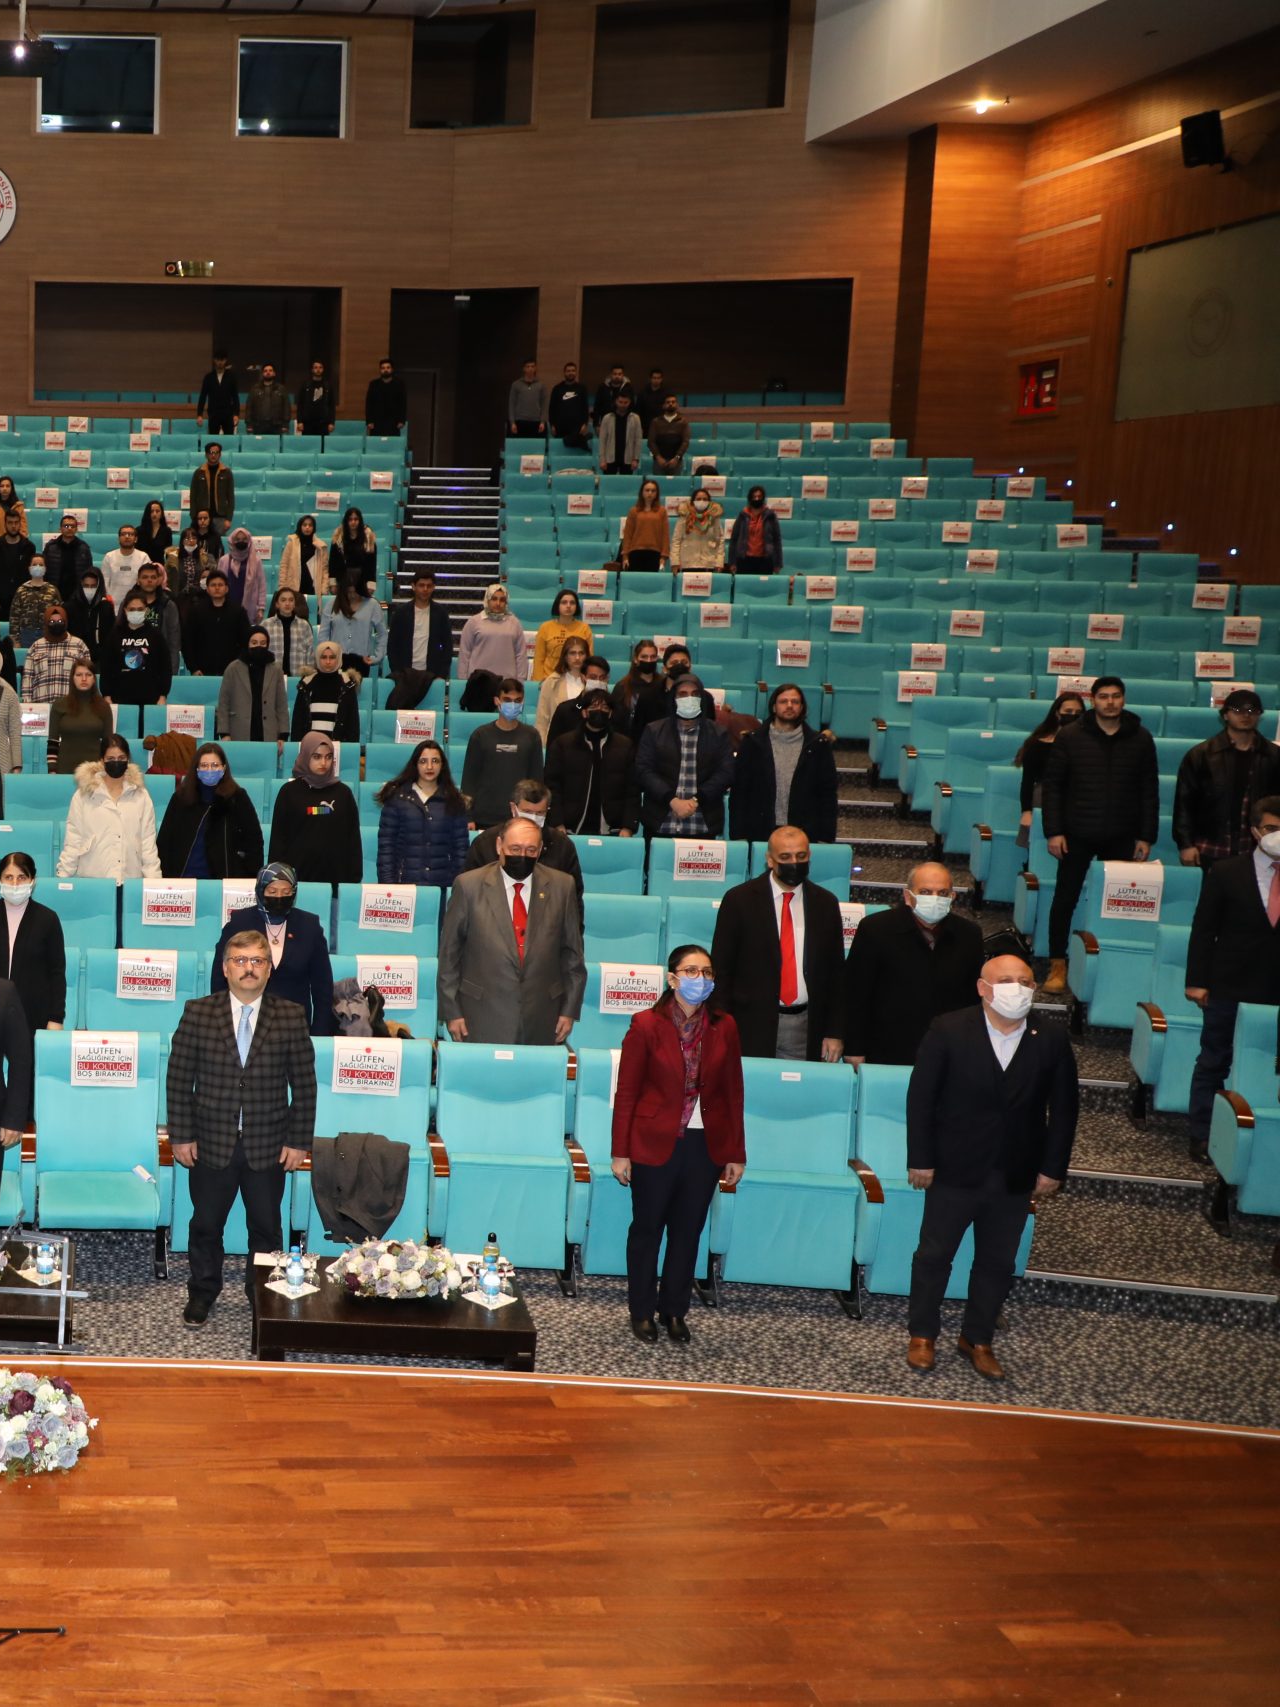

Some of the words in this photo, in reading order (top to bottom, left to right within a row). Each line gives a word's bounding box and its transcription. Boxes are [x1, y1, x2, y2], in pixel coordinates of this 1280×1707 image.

[121, 638, 150, 646] NASA
[375, 898, 402, 906] LÜTFEN
[136, 978, 171, 986] KOLTUĞU
[620, 992, 656, 1000] KOLTUĞU
[351, 1054, 385, 1063] LÜTFEN
[92, 1062, 131, 1070] KOLTUĞU
[339, 1062, 378, 1070] SAĞLIĞINIZ
[354, 1071, 394, 1080] KOLTUĞU
[357, 1079, 394, 1087] BIRAKINIZ
